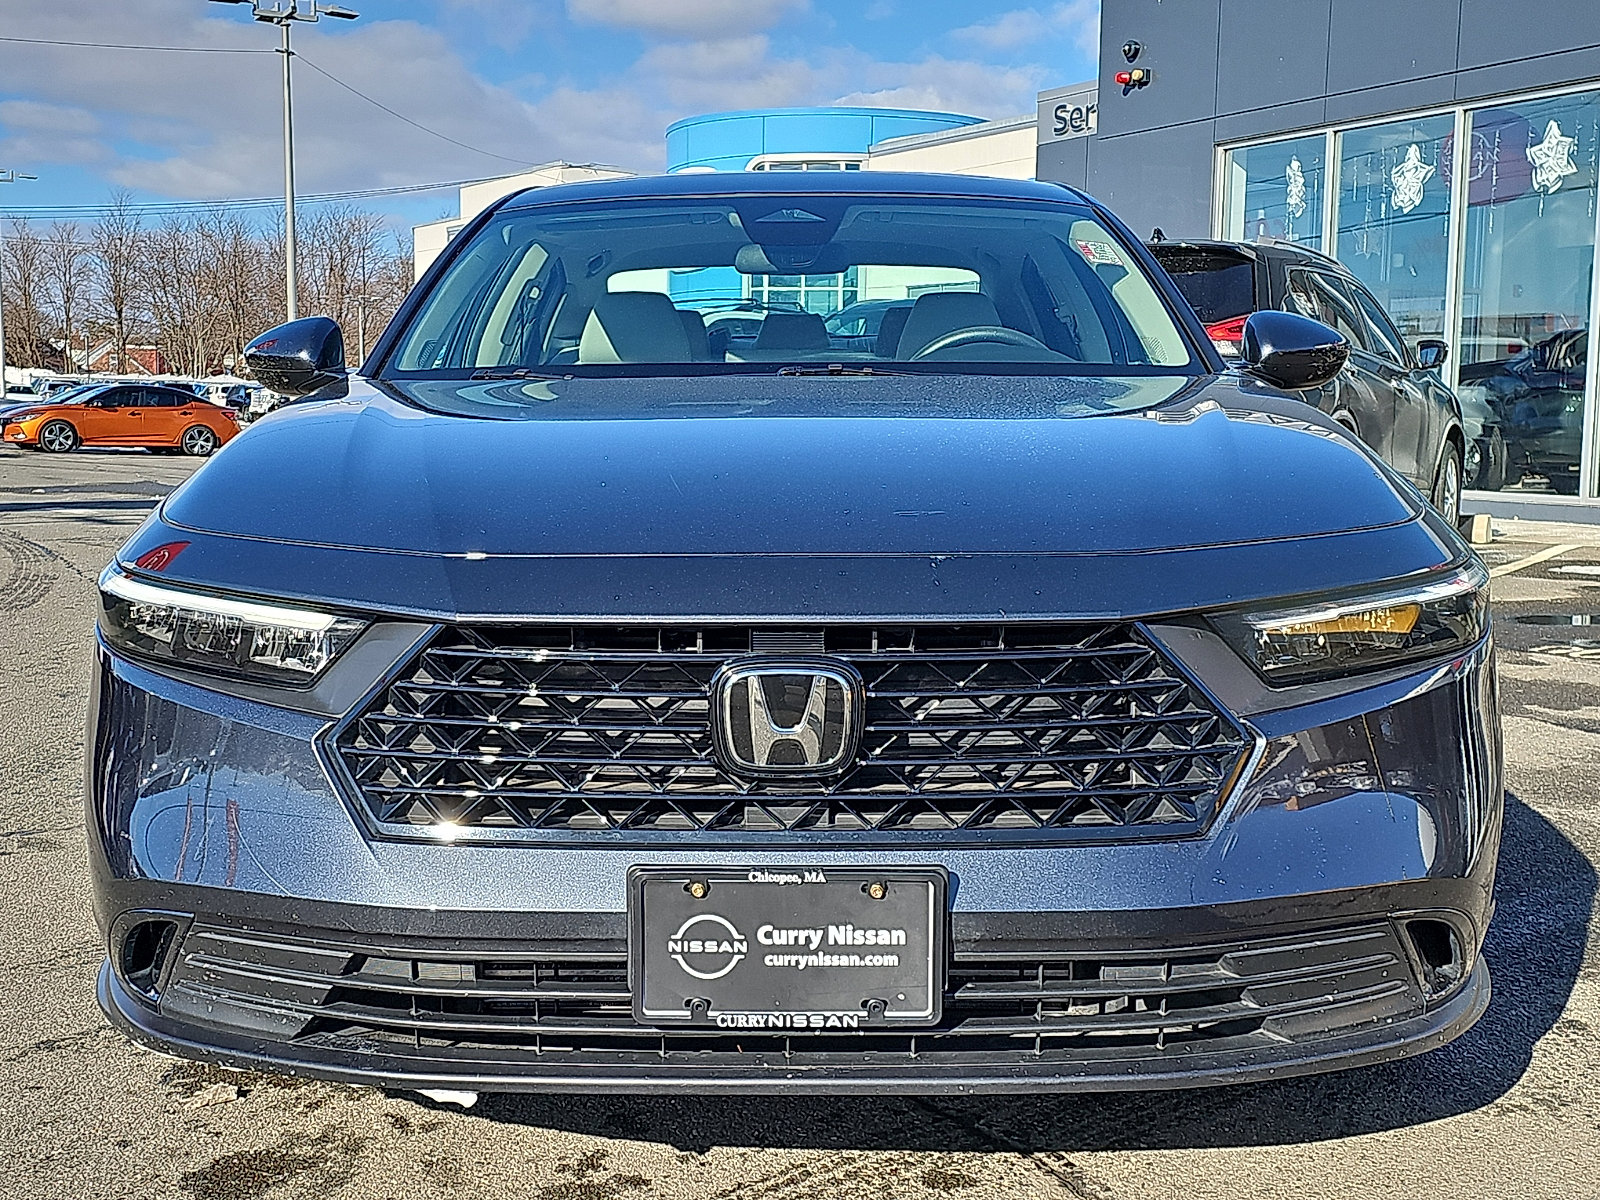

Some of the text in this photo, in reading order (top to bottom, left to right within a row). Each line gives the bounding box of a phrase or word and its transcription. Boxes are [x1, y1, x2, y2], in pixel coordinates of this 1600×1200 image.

[748, 870, 826, 885] Chicopee, MA
[757, 924, 906, 950] Curry Nissan
[668, 940, 747, 953] NISSAN
[764, 951, 899, 970] currynissan.com
